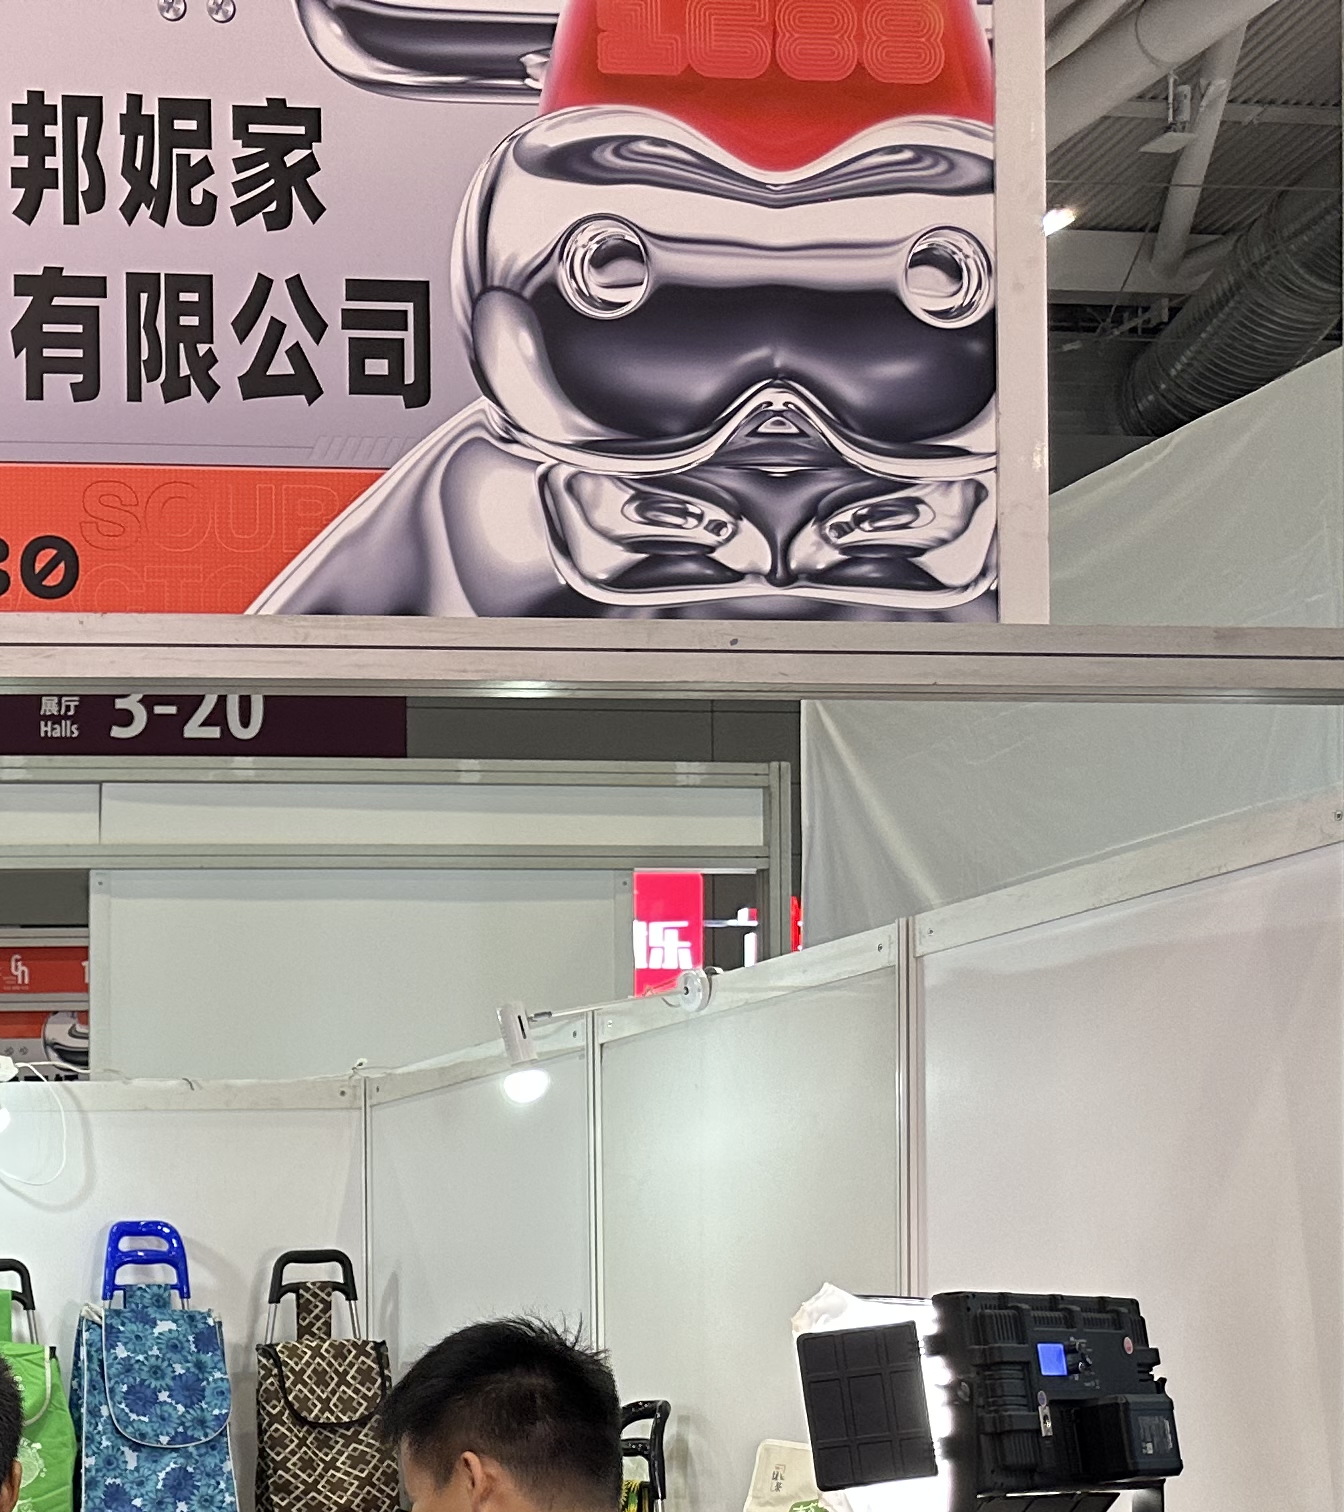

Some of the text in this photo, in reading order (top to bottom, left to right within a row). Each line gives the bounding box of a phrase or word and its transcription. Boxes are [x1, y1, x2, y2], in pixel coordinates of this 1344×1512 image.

[40, 696, 79, 716] 展厅
[40, 694, 264, 740] Halls 3-20
